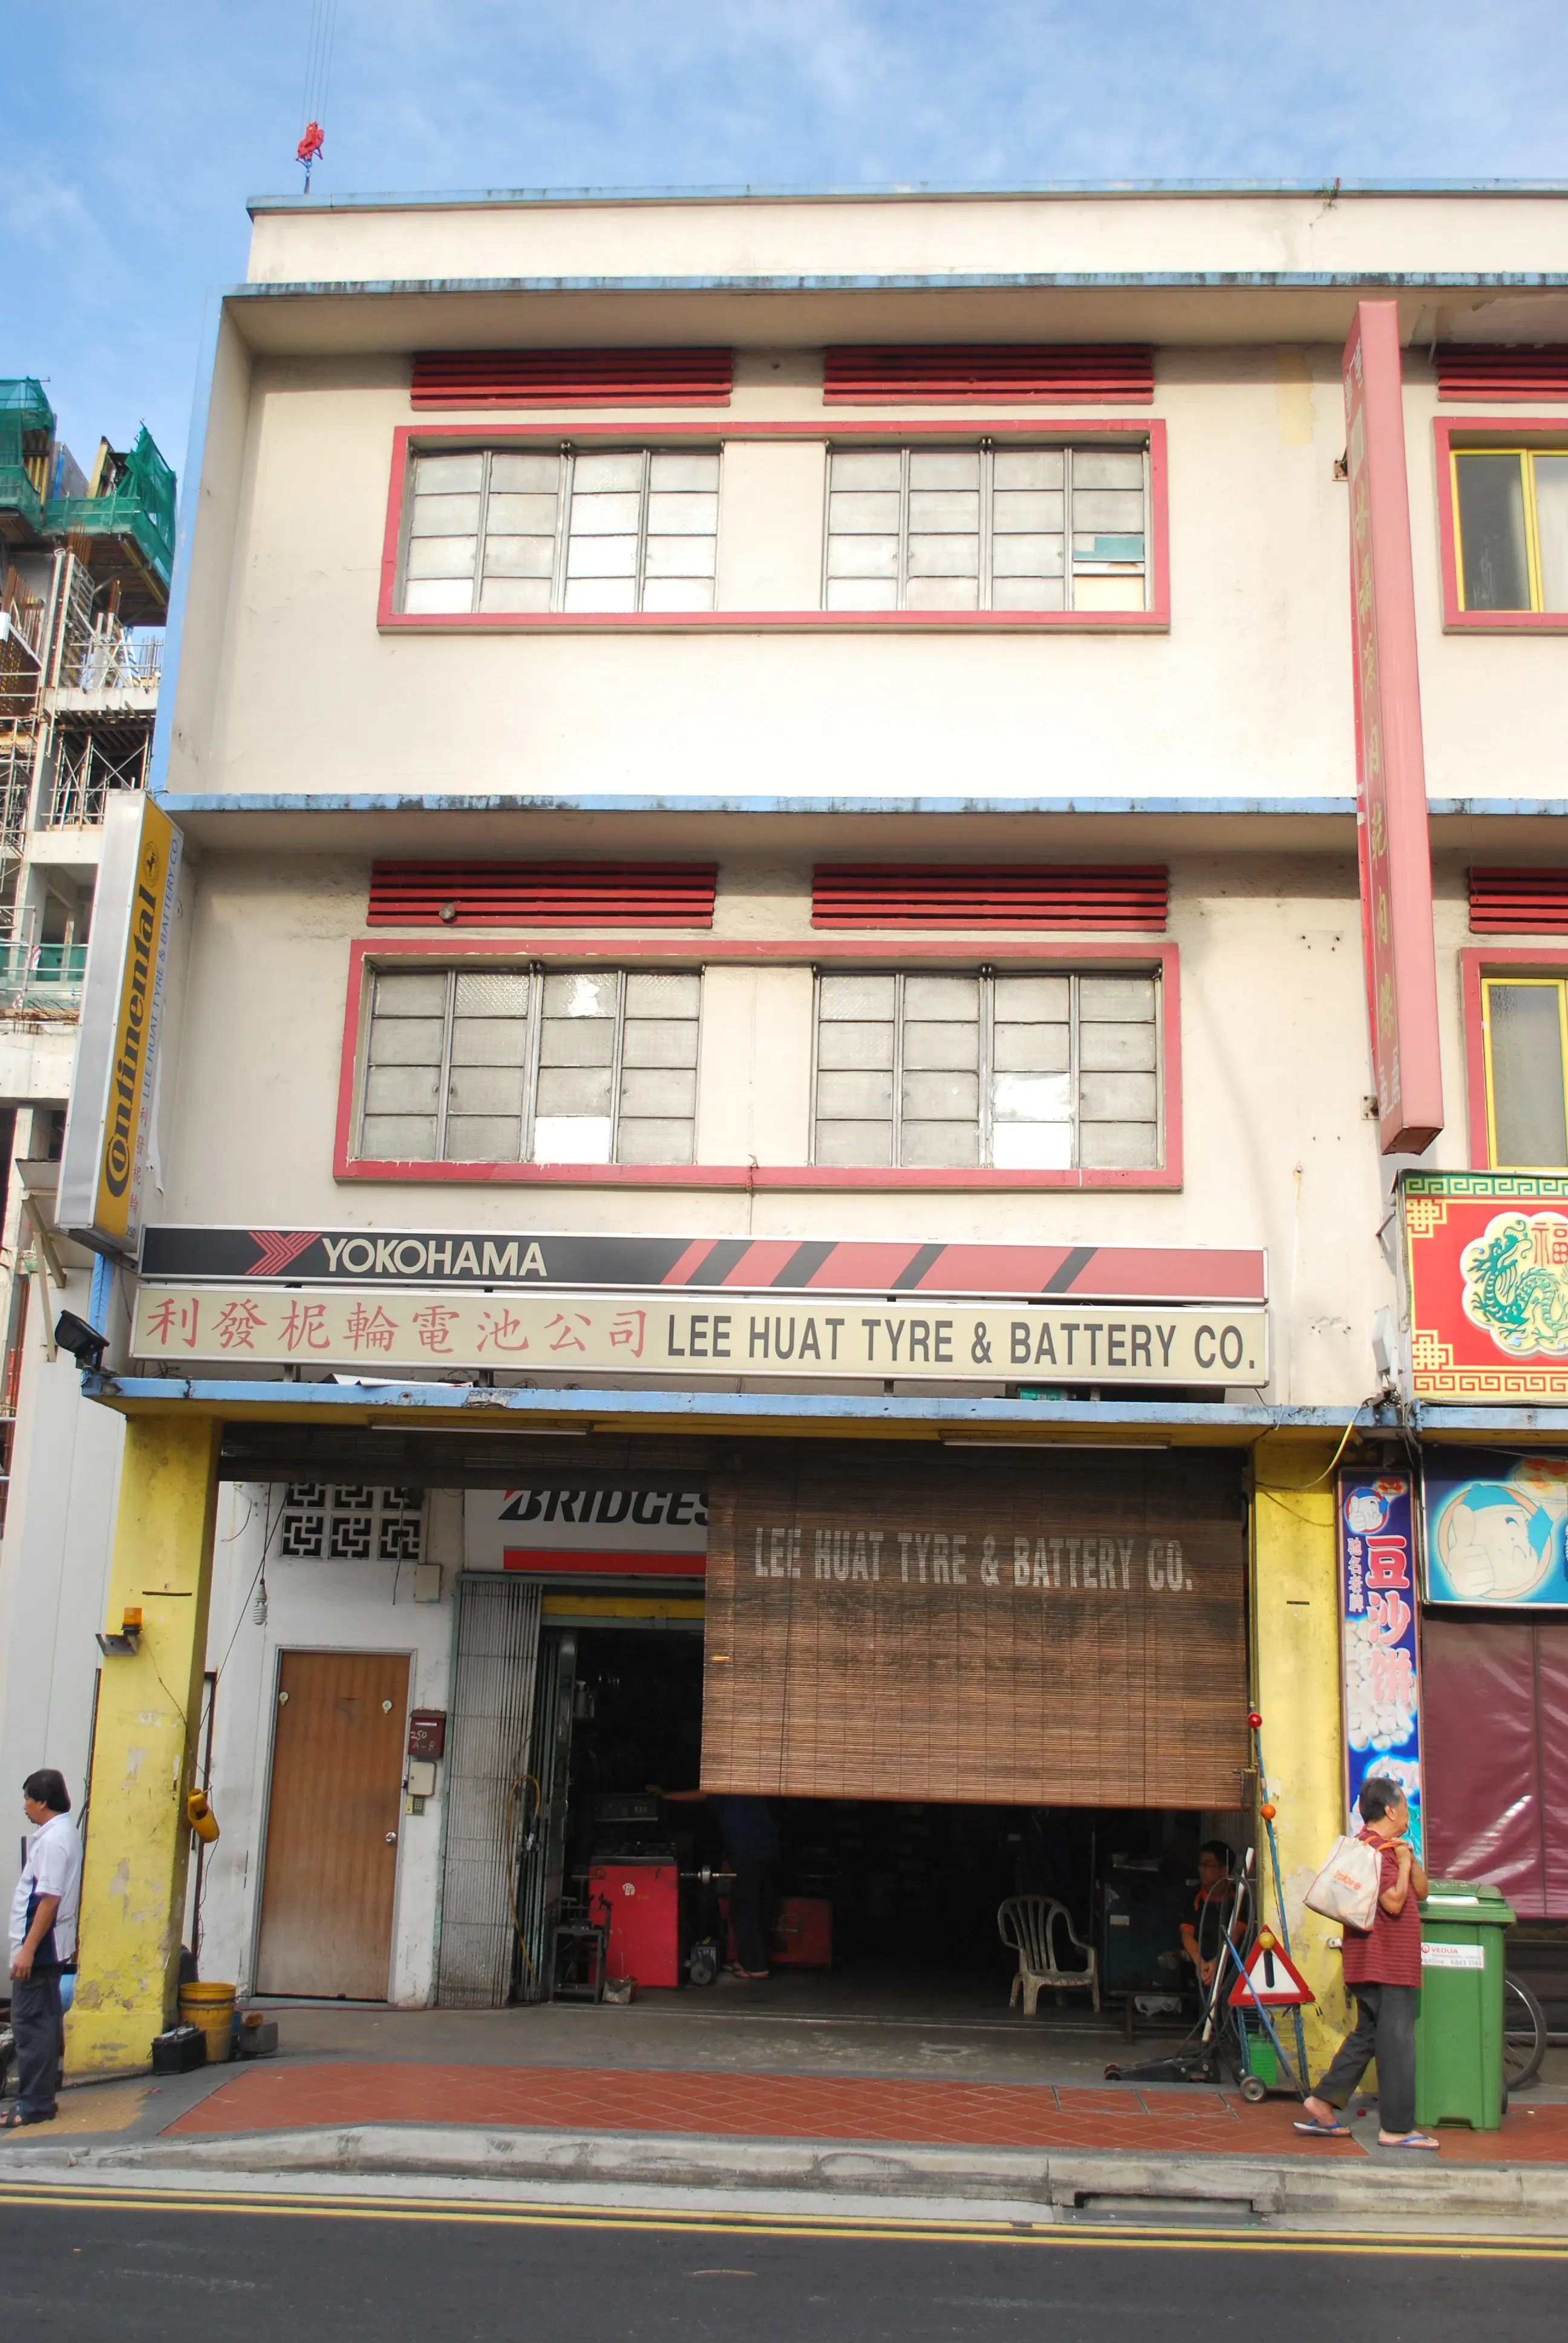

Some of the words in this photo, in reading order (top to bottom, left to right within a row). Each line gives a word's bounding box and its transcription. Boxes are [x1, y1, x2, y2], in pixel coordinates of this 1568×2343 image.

[160, 870, 175, 945] BATTERY
[158, 950, 166, 962] &
[152, 965, 165, 1008] TYRE
[105, 883, 157, 1198] Continental
[146, 1012, 158, 1063] HUAT
[142, 1067, 152, 1098] LEE
[126, 1225, 136, 1239] 250
[321, 1237, 547, 1277] YOKOHAMA
[668, 1314, 733, 1358] LEE
[749, 1316, 846, 1360] HUAT
[861, 1319, 953, 1363] TYRE
[972, 1320, 992, 1364] &
[1010, 1322, 1178, 1368] BATTERY
[1194, 1325, 1255, 1370] CO.
[755, 1527, 802, 1579] LEE
[815, 1530, 884, 1581] HUAT
[897, 1533, 967, 1584] TYRE
[980, 1535, 1000, 1587] &
[1014, 1536, 1134, 1590] BATTERY
[1148, 1539, 1193, 1591] CO.
[1347, 1537, 1364, 1612] 驰名老牌
[1365, 1535, 1413, 1703] 豆沙饼
[410, 1729, 427, 1740] 250
